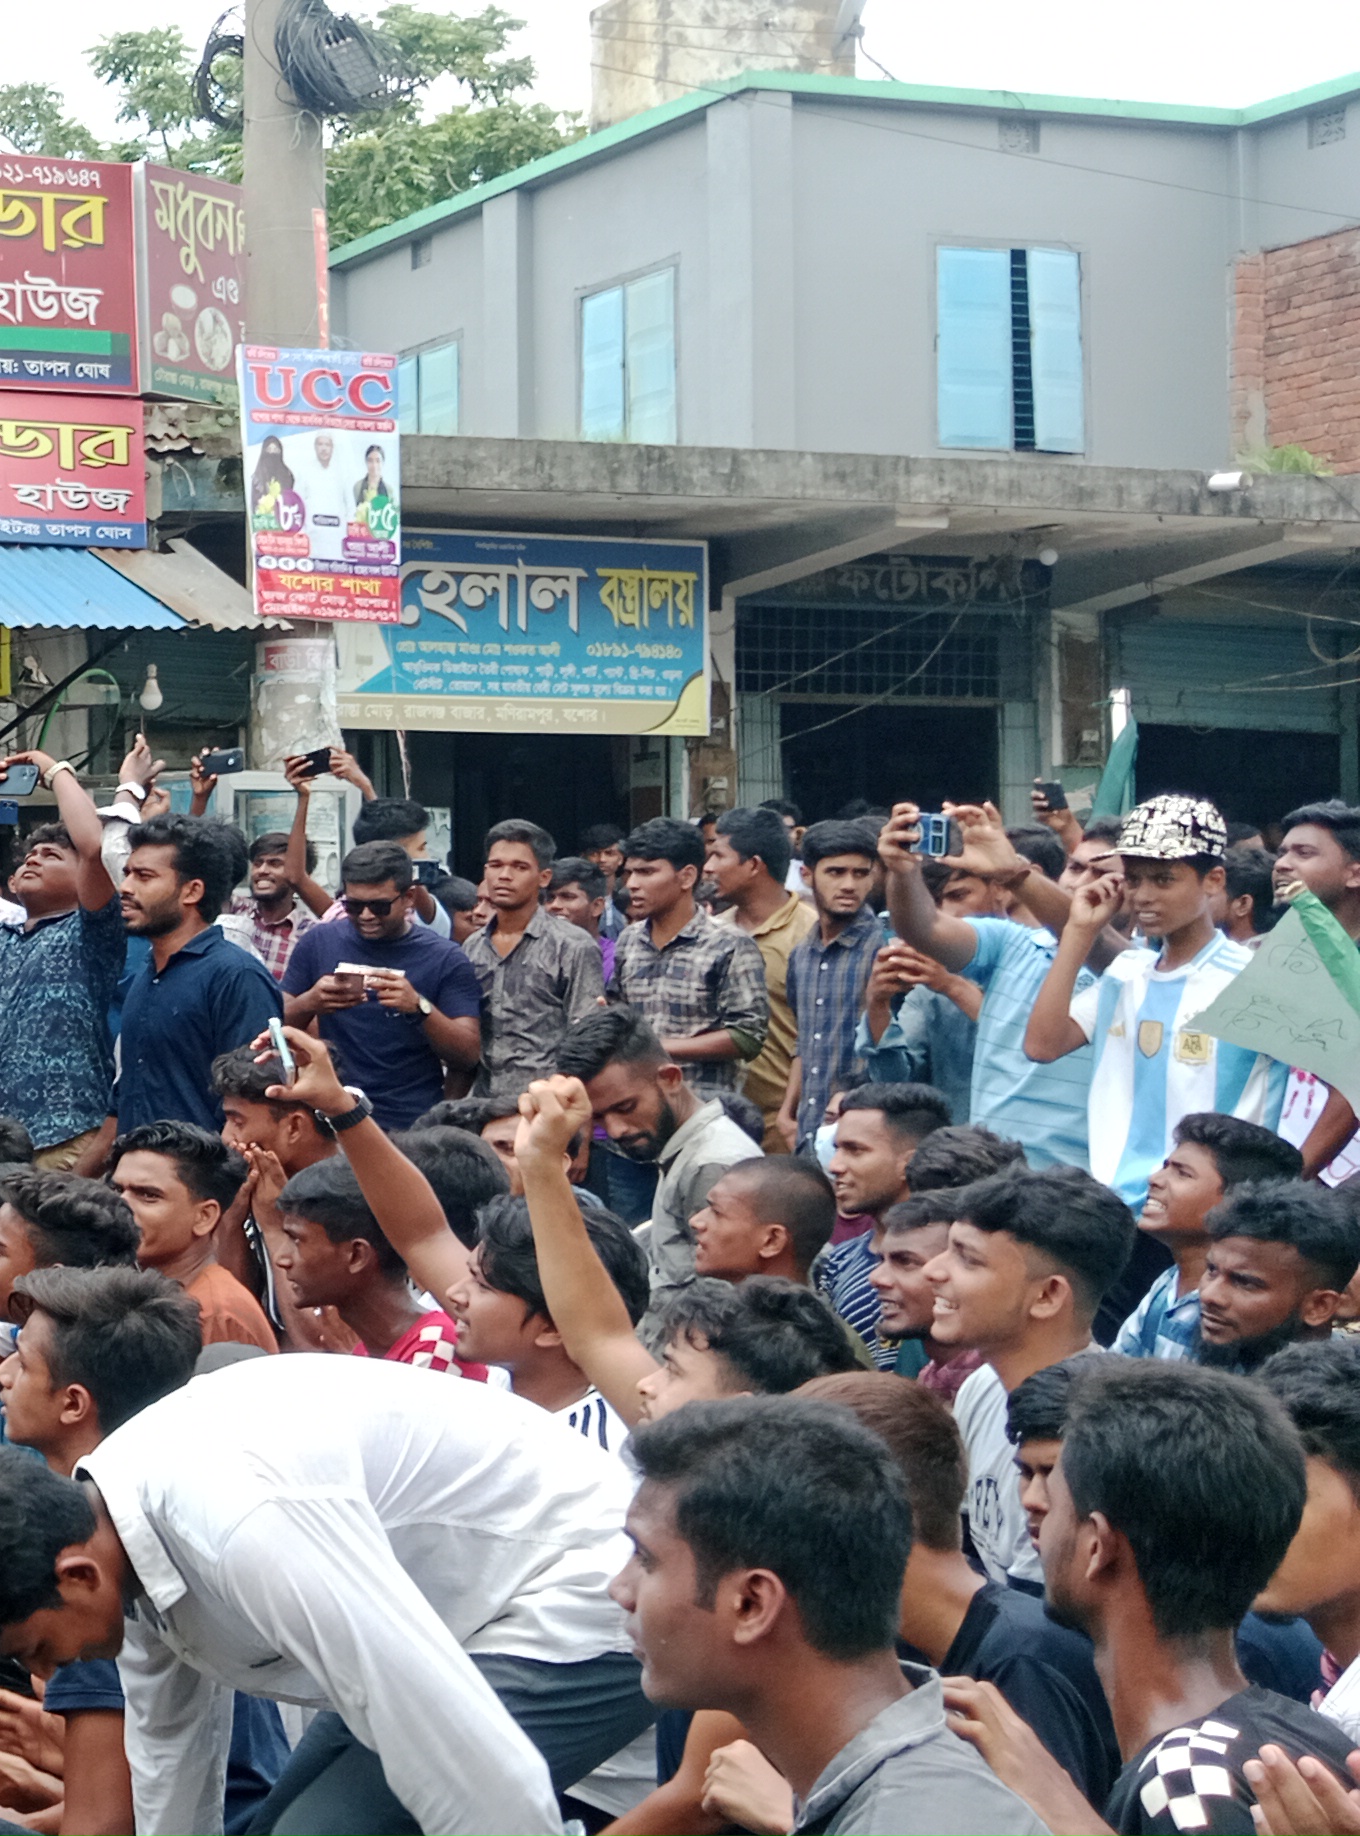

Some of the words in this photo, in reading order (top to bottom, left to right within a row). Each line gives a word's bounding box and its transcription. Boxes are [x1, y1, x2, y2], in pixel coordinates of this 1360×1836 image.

[150, 180, 235, 284] মধুবন
[23, 358, 71, 377] তাপস
[248, 364, 395, 416] UCC
[9, 477, 135, 514] হাউজ
[46, 523, 91, 539] তাপস
[279, 574, 334, 593] যশোর
[339, 577, 382, 596] শাখা
[399, 557, 589, 634] হেলাল
[596, 564, 698, 630] বস্ত্রালয়
